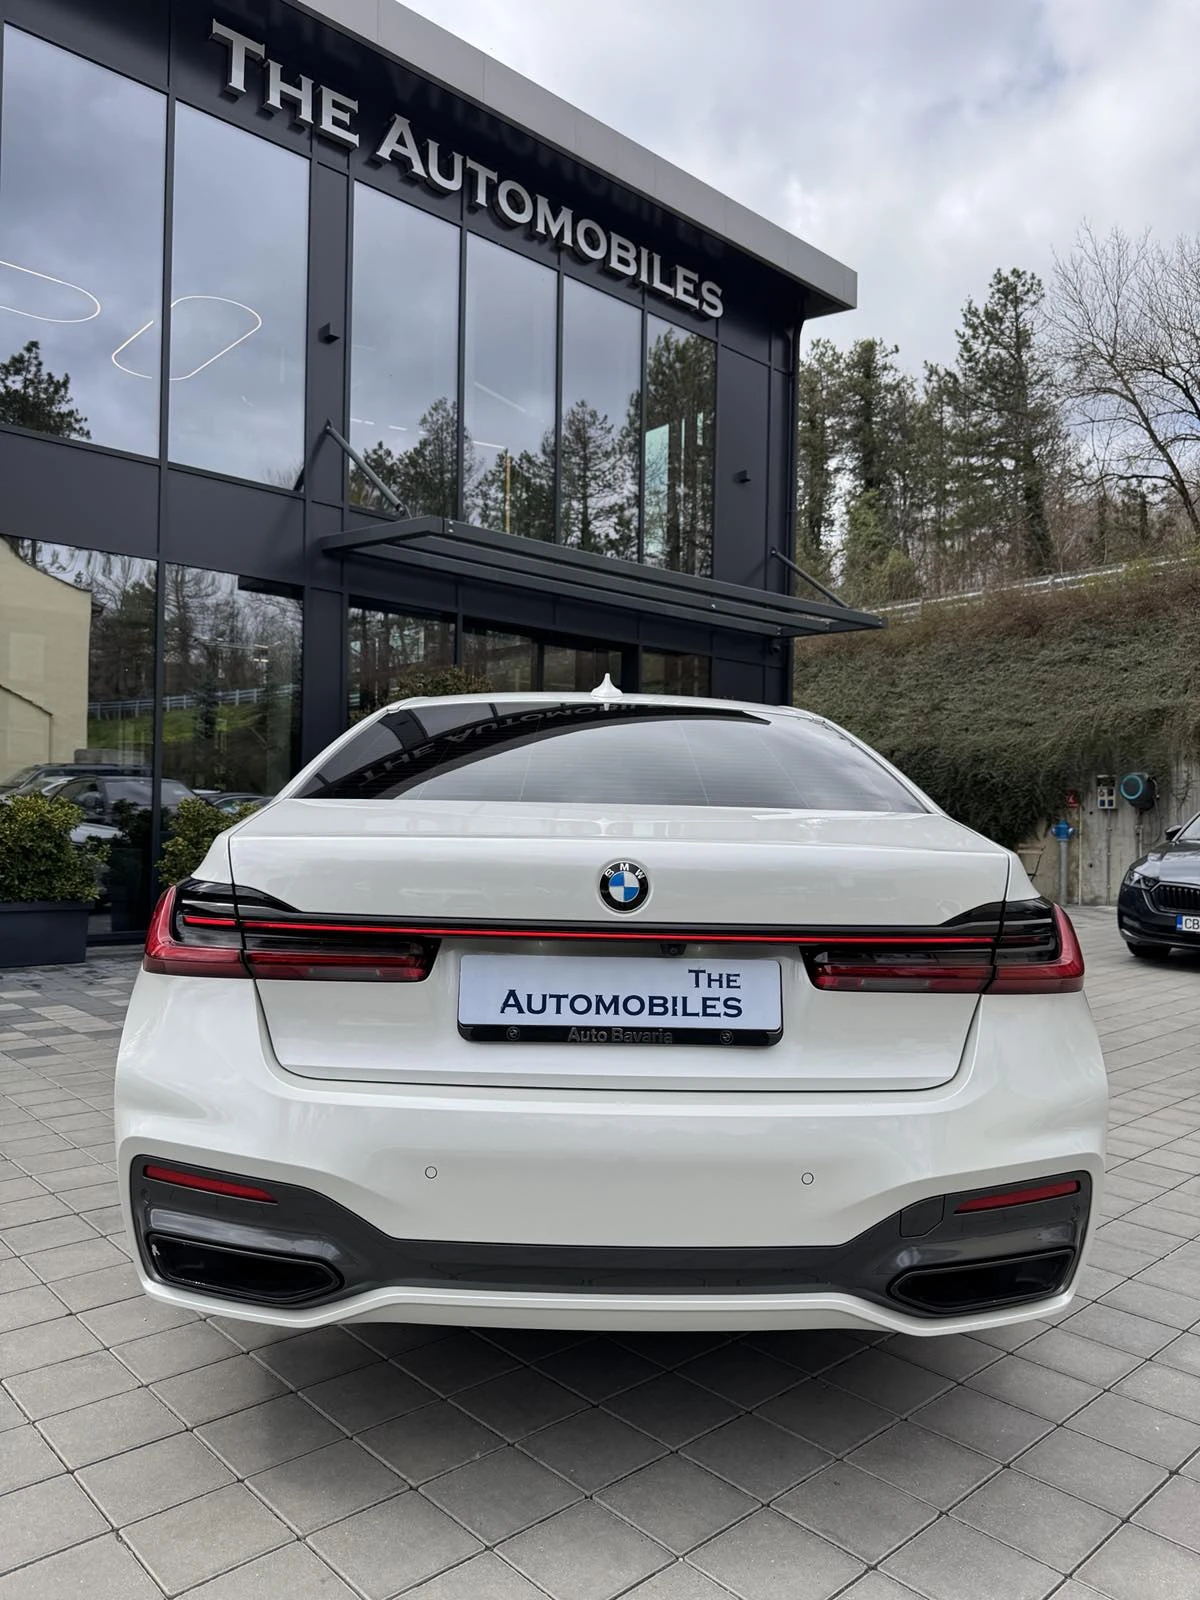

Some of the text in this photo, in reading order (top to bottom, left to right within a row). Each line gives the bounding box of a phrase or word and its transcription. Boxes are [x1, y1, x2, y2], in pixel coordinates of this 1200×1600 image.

[210, 19, 360, 150] THE
[374, 113, 725, 319] AUTOMOBILES
[605, 863, 645, 879] BMW
[688, 968, 742, 989] THE
[500, 989, 743, 1018] AUTOMOBILES
[567, 1026, 673, 1044] Auto Bavaria
